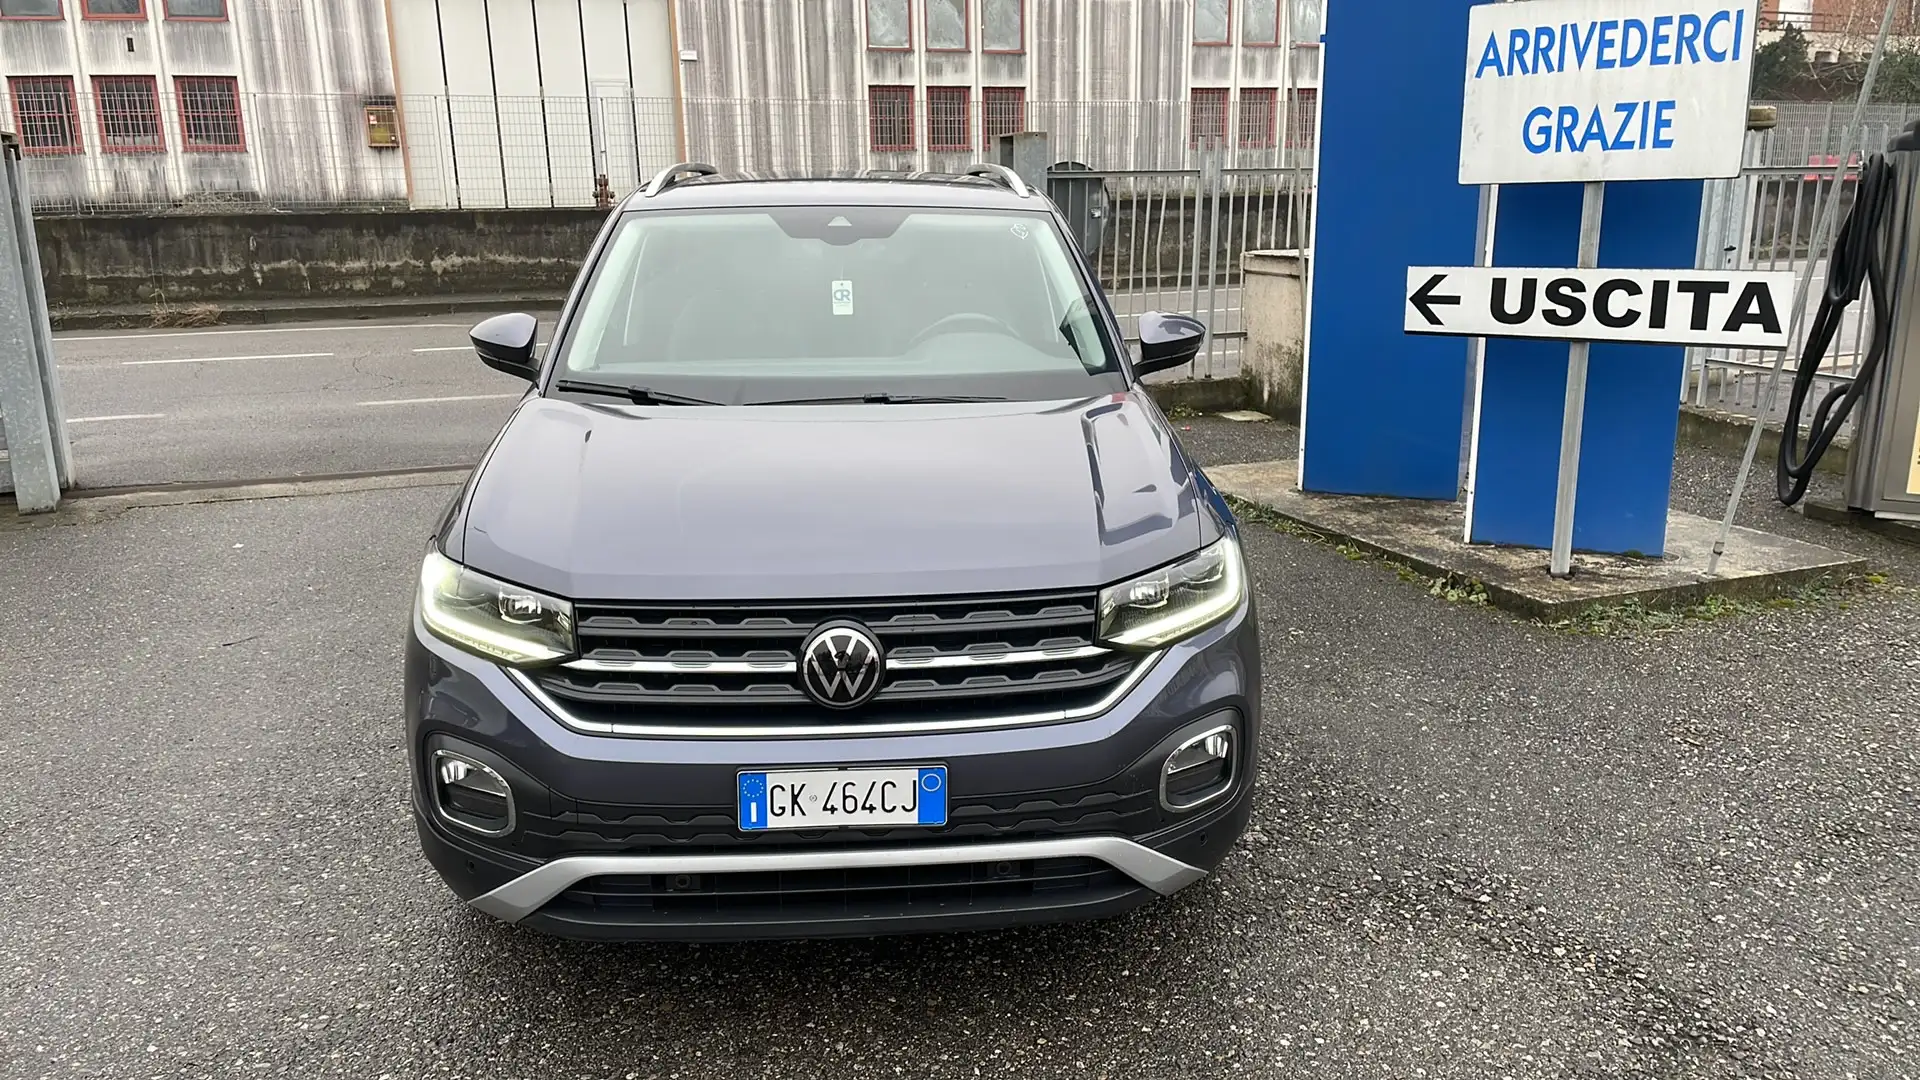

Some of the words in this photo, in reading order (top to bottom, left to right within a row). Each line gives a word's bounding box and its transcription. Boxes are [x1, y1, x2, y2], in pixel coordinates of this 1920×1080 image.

[1474, 9, 1745, 79] ARRIVEDERCI
[1522, 100, 1676, 154] GRAZIE
[1489, 277, 1783, 335] USCITA
[805, 630, 878, 702] VW
[769, 783, 807, 817] GK
[822, 779, 917, 815] 464CJ
